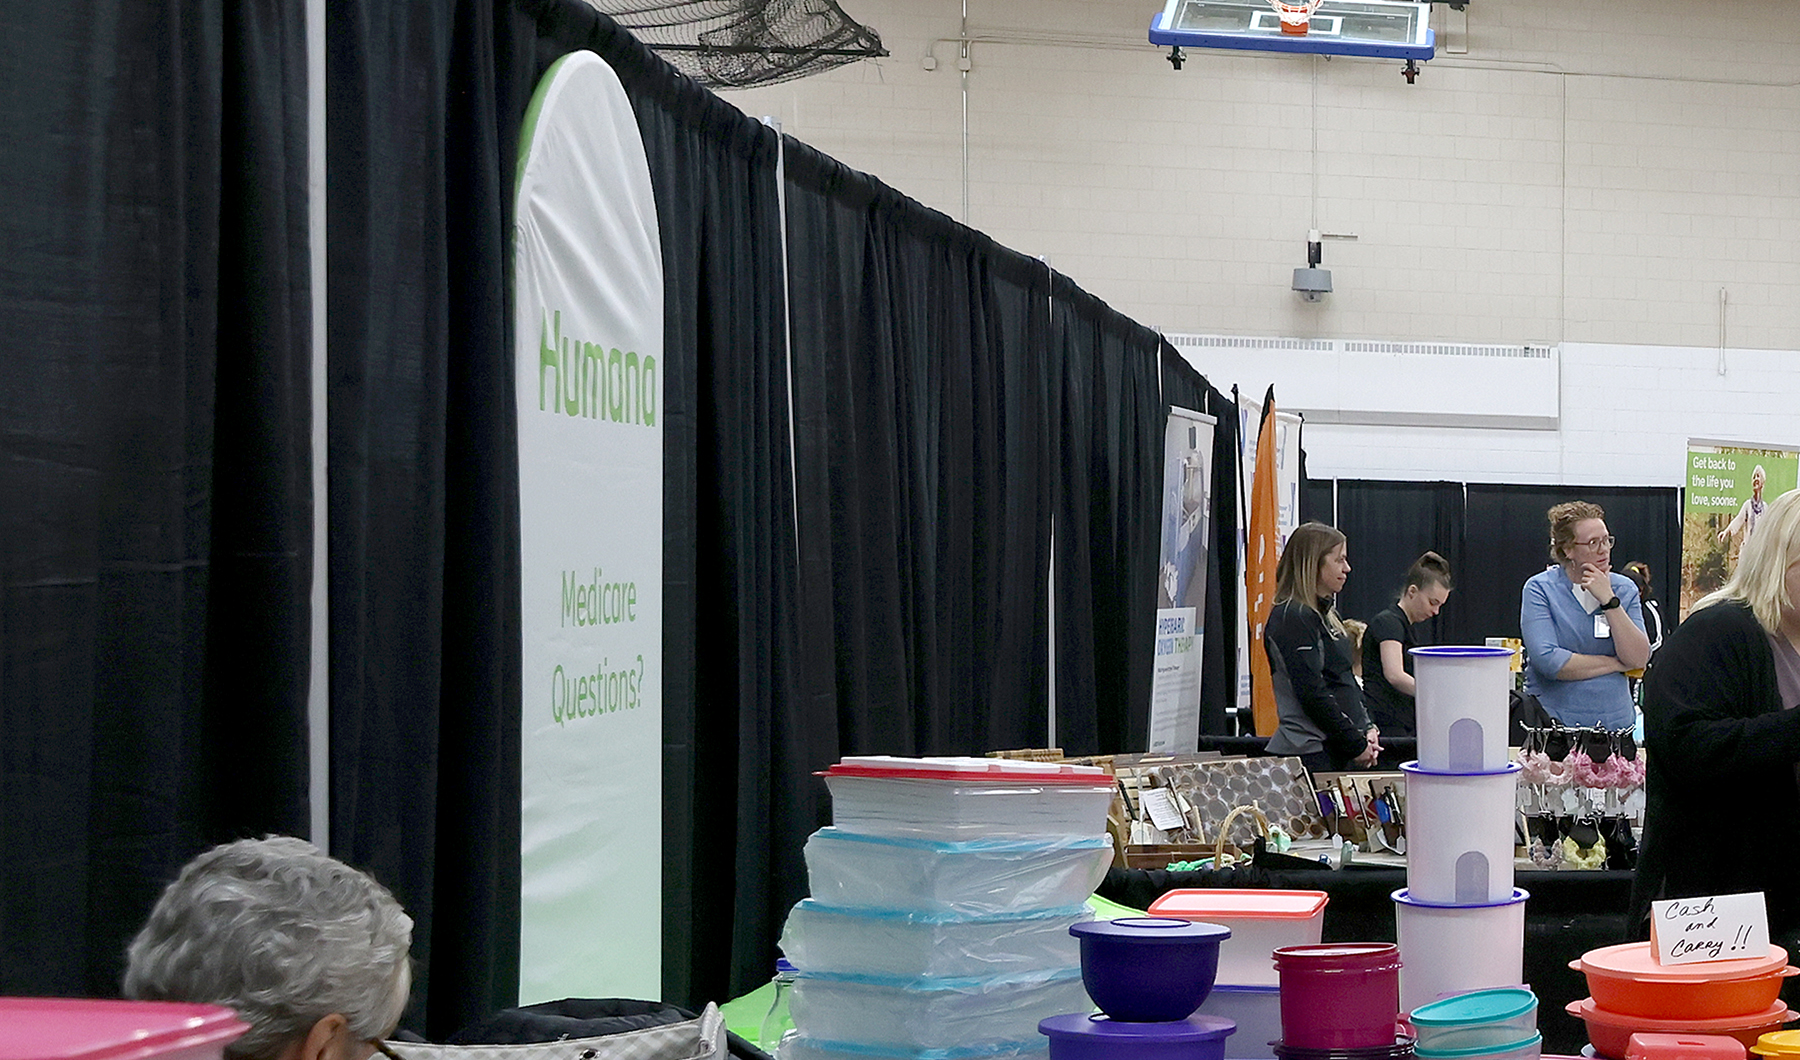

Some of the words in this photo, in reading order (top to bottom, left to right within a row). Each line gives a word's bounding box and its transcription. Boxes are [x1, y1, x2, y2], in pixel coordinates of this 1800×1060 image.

[539, 308, 657, 428] Humana
[1692, 456, 1707, 469] Get
[1707, 457, 1727, 471] back
[1727, 459, 1736, 471] to
[1692, 475, 1705, 488] the
[1706, 475, 1720, 488] life
[1720, 478, 1734, 492] you
[1691, 493, 1710, 507] love,
[1711, 496, 1738, 507] sooner.
[561, 567, 637, 628] Medicare
[551, 654, 645, 729] Questions?
[1665, 897, 1715, 920] Cash
[1685, 917, 1718, 932] and
